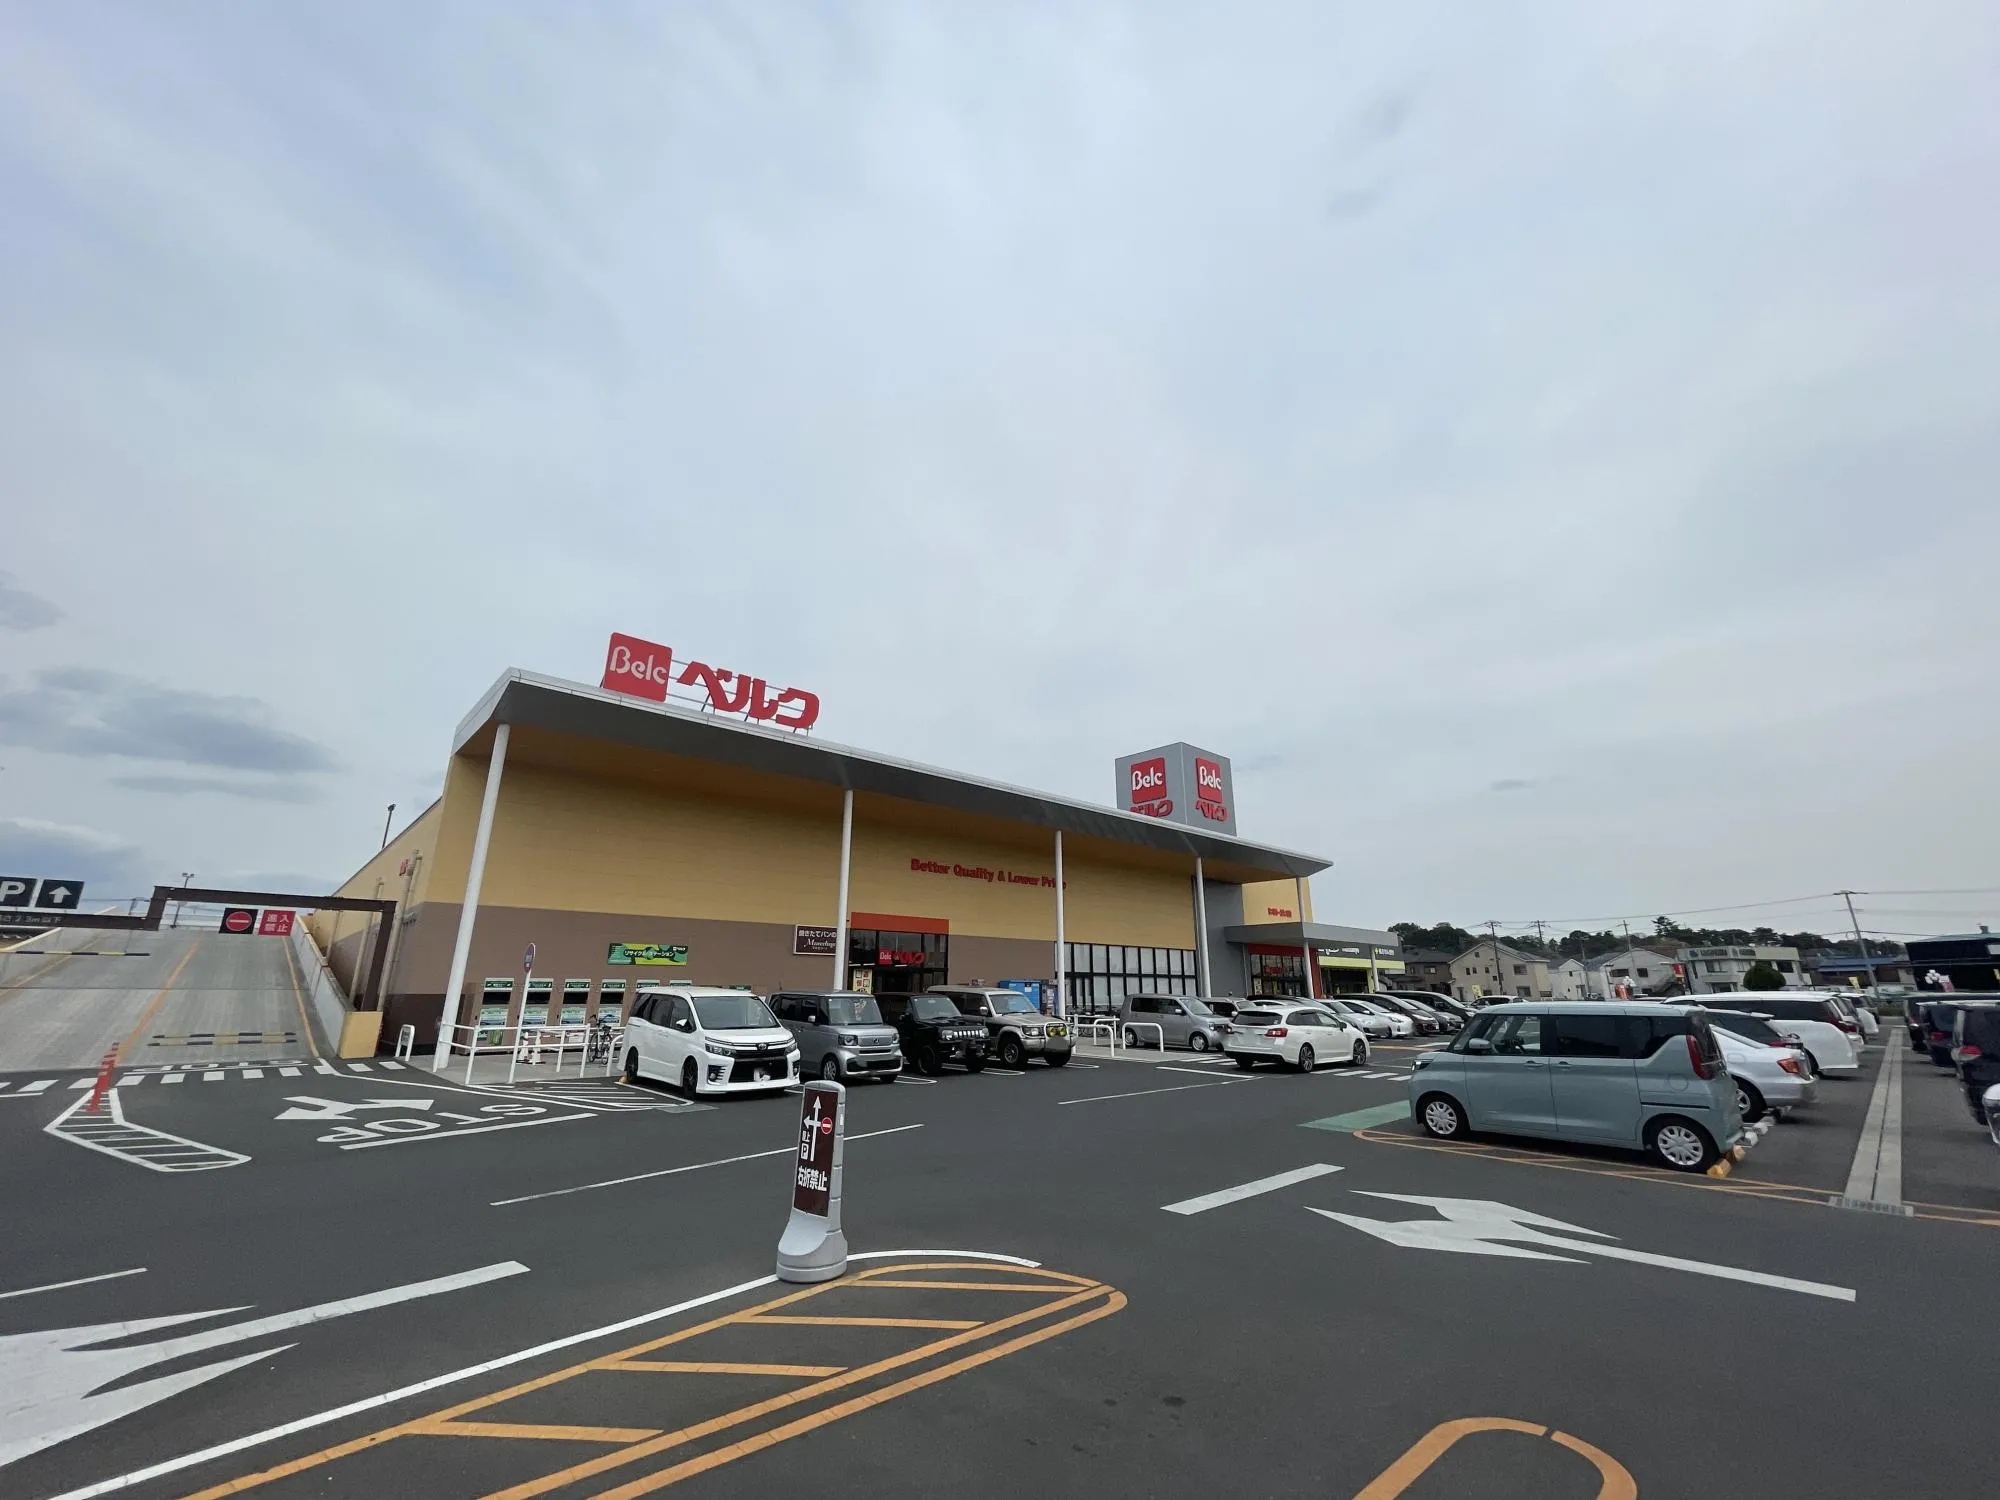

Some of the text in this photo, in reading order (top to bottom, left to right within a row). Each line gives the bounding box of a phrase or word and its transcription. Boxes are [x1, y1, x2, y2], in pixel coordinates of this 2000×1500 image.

[609, 645, 668, 685] Belc
[677, 661, 820, 729] ベルク
[1132, 766, 1164, 791] Belc
[1199, 766, 1222, 790] Belc
[911, 858, 950, 874] Better
[953, 864, 994, 882] Quality
[997, 870, 1006, 882] &
[1008, 872, 1040, 886] Lower
[316, 1104, 548, 1142] STOP
[798, 1166, 828, 1192] 右折禁止
